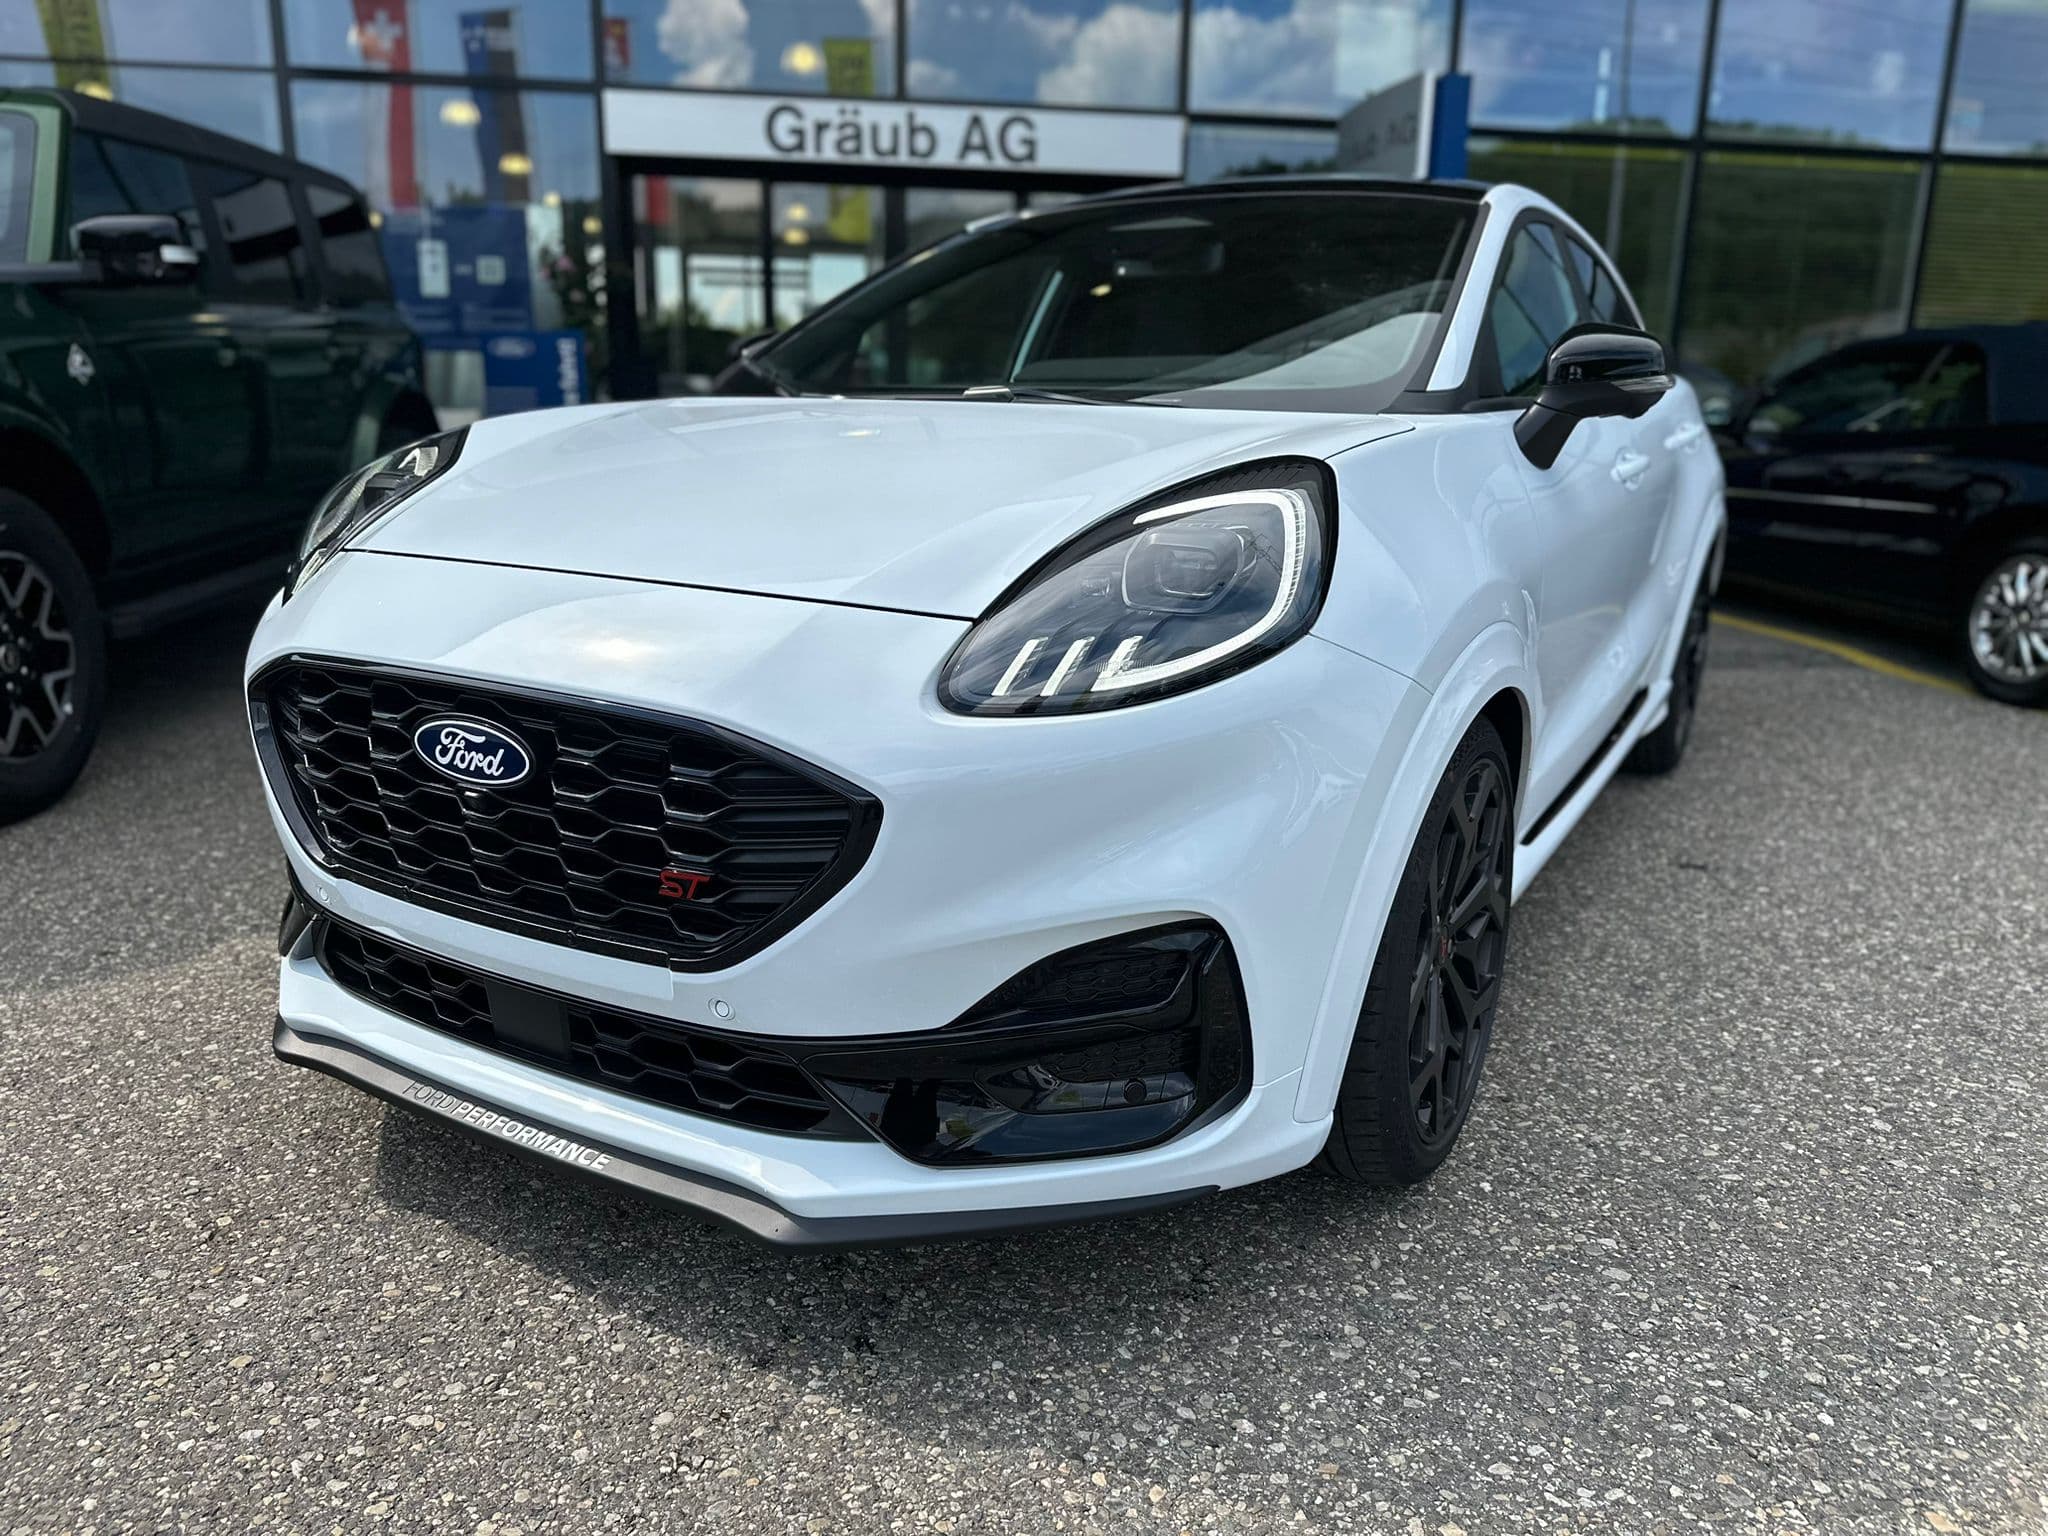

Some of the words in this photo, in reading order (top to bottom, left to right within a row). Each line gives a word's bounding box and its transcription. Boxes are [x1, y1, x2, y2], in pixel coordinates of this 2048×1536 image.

[766, 104, 937, 158] Gräub
[957, 113, 1038, 163] AG
[435, 727, 505, 777] Ford
[658, 869, 712, 900] ST
[402, 1080, 457, 1111] FORD
[452, 1101, 612, 1170] PERFORMANCE
